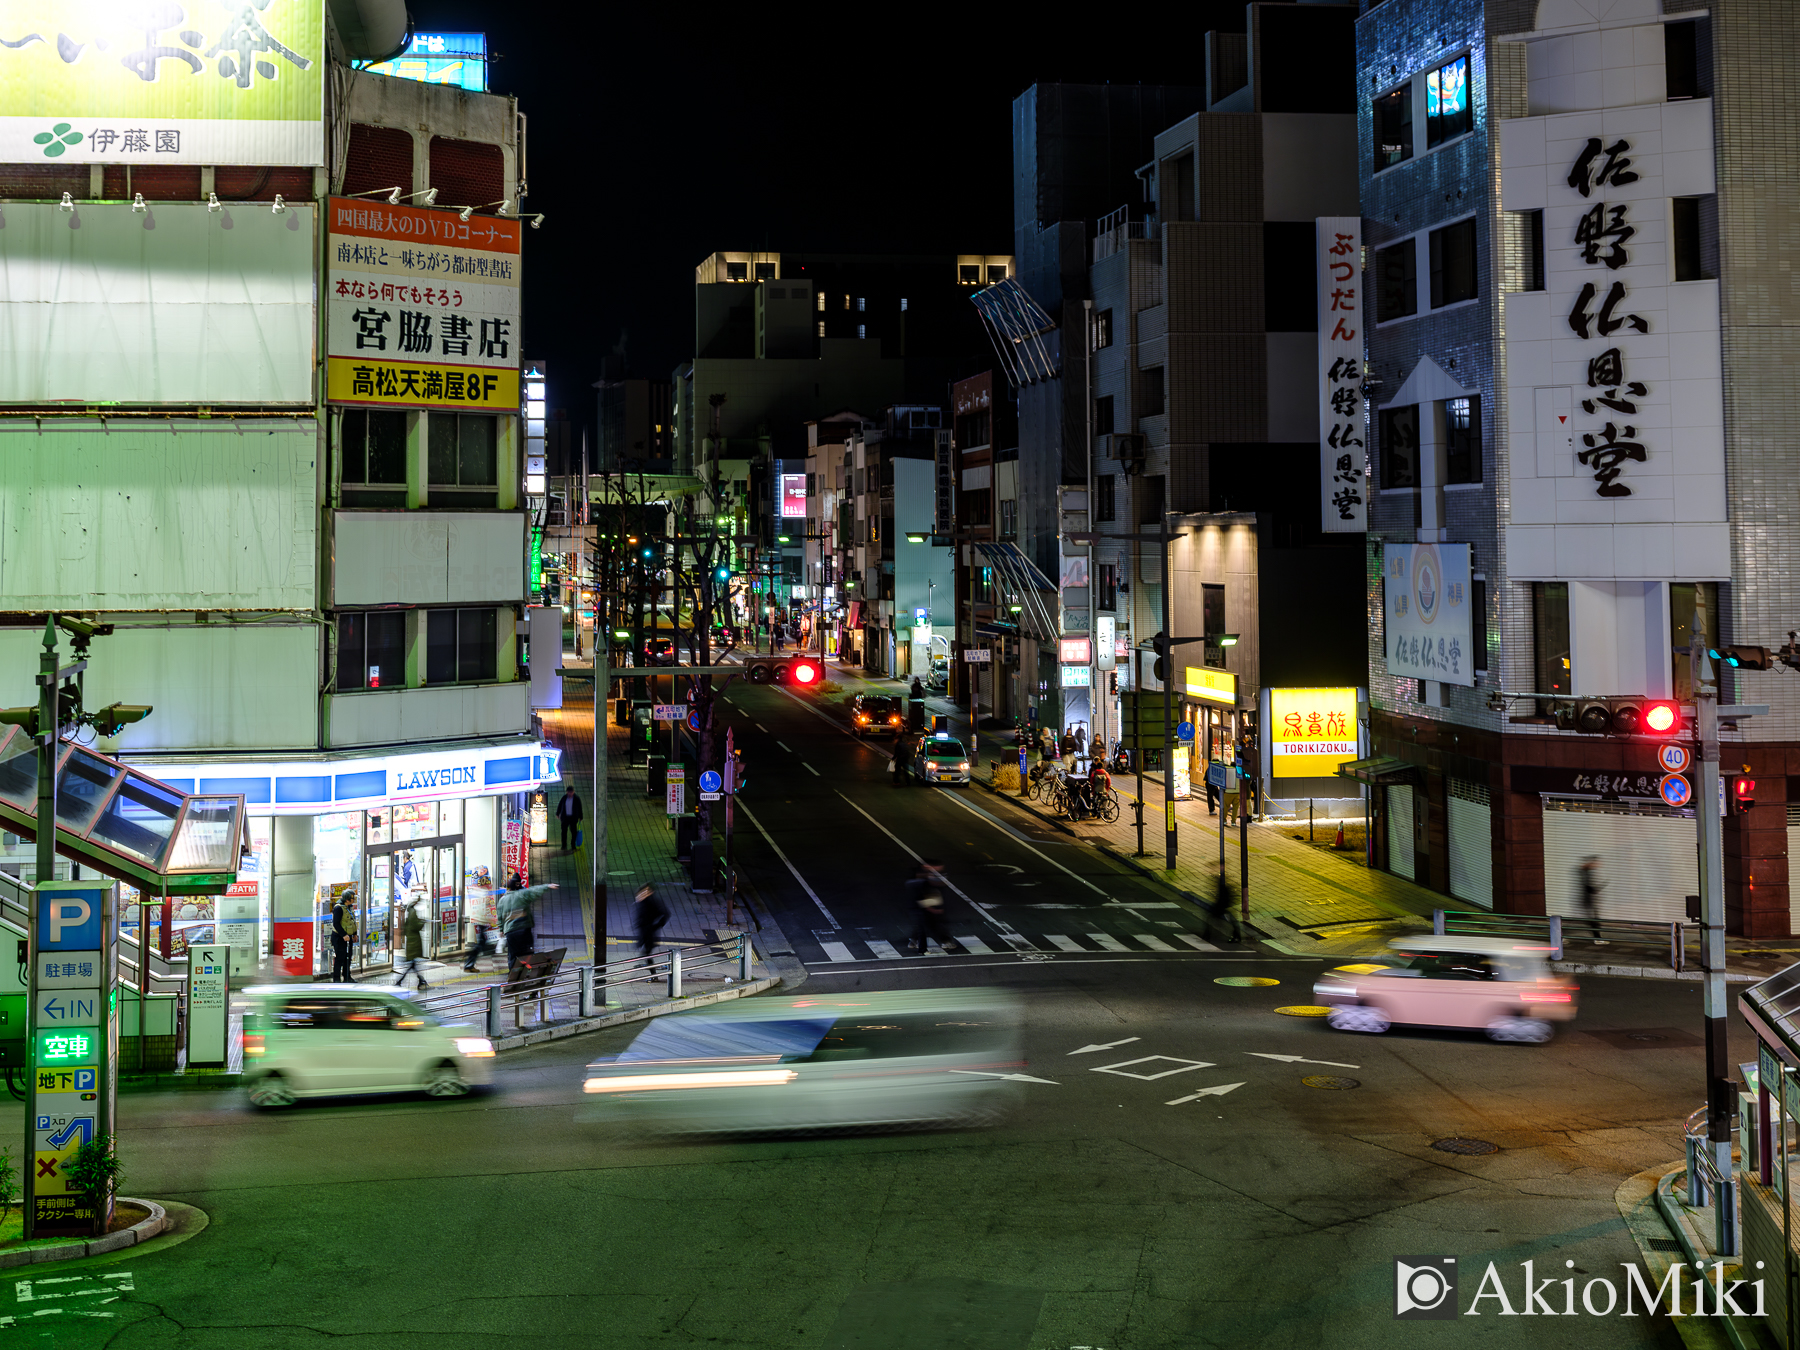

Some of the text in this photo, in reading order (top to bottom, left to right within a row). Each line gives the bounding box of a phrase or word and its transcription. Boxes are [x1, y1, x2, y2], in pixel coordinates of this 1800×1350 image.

[88, 128, 181, 154] 伊藤園
[337, 208, 513, 244] 四国最大のDVDコーナー
[337, 242, 512, 280] 南本店と一味ちがう都市型書店
[335, 279, 463, 307] 本なら何でもそろう
[1567, 137, 1648, 497] 佐野仏恩堂
[352, 307, 511, 359] 宮脇書店
[352, 366, 498, 401] 高松天満屋8F
[1327, 233, 1363, 520] ぶつだん 佐野仏恩堂
[1395, 634, 1462, 675] 佐野仏恩堂
[1283, 711, 1347, 737] 鳥貴族
[1283, 743, 1348, 754] TORIKIZOKU
[1666, 750, 1682, 764] 40
[397, 766, 477, 790] LAWSON
[50, 898, 91, 942] P
[283, 938, 304, 960] 薬
[45, 963, 93, 978] 駐車場
[70, 999, 93, 1018] IN
[45, 1035, 89, 1058] 空車
[39, 1071, 92, 1089] 地下 P
[52, 1118, 66, 1126] 入口
[36, 1199, 76, 1208] 手前側は
